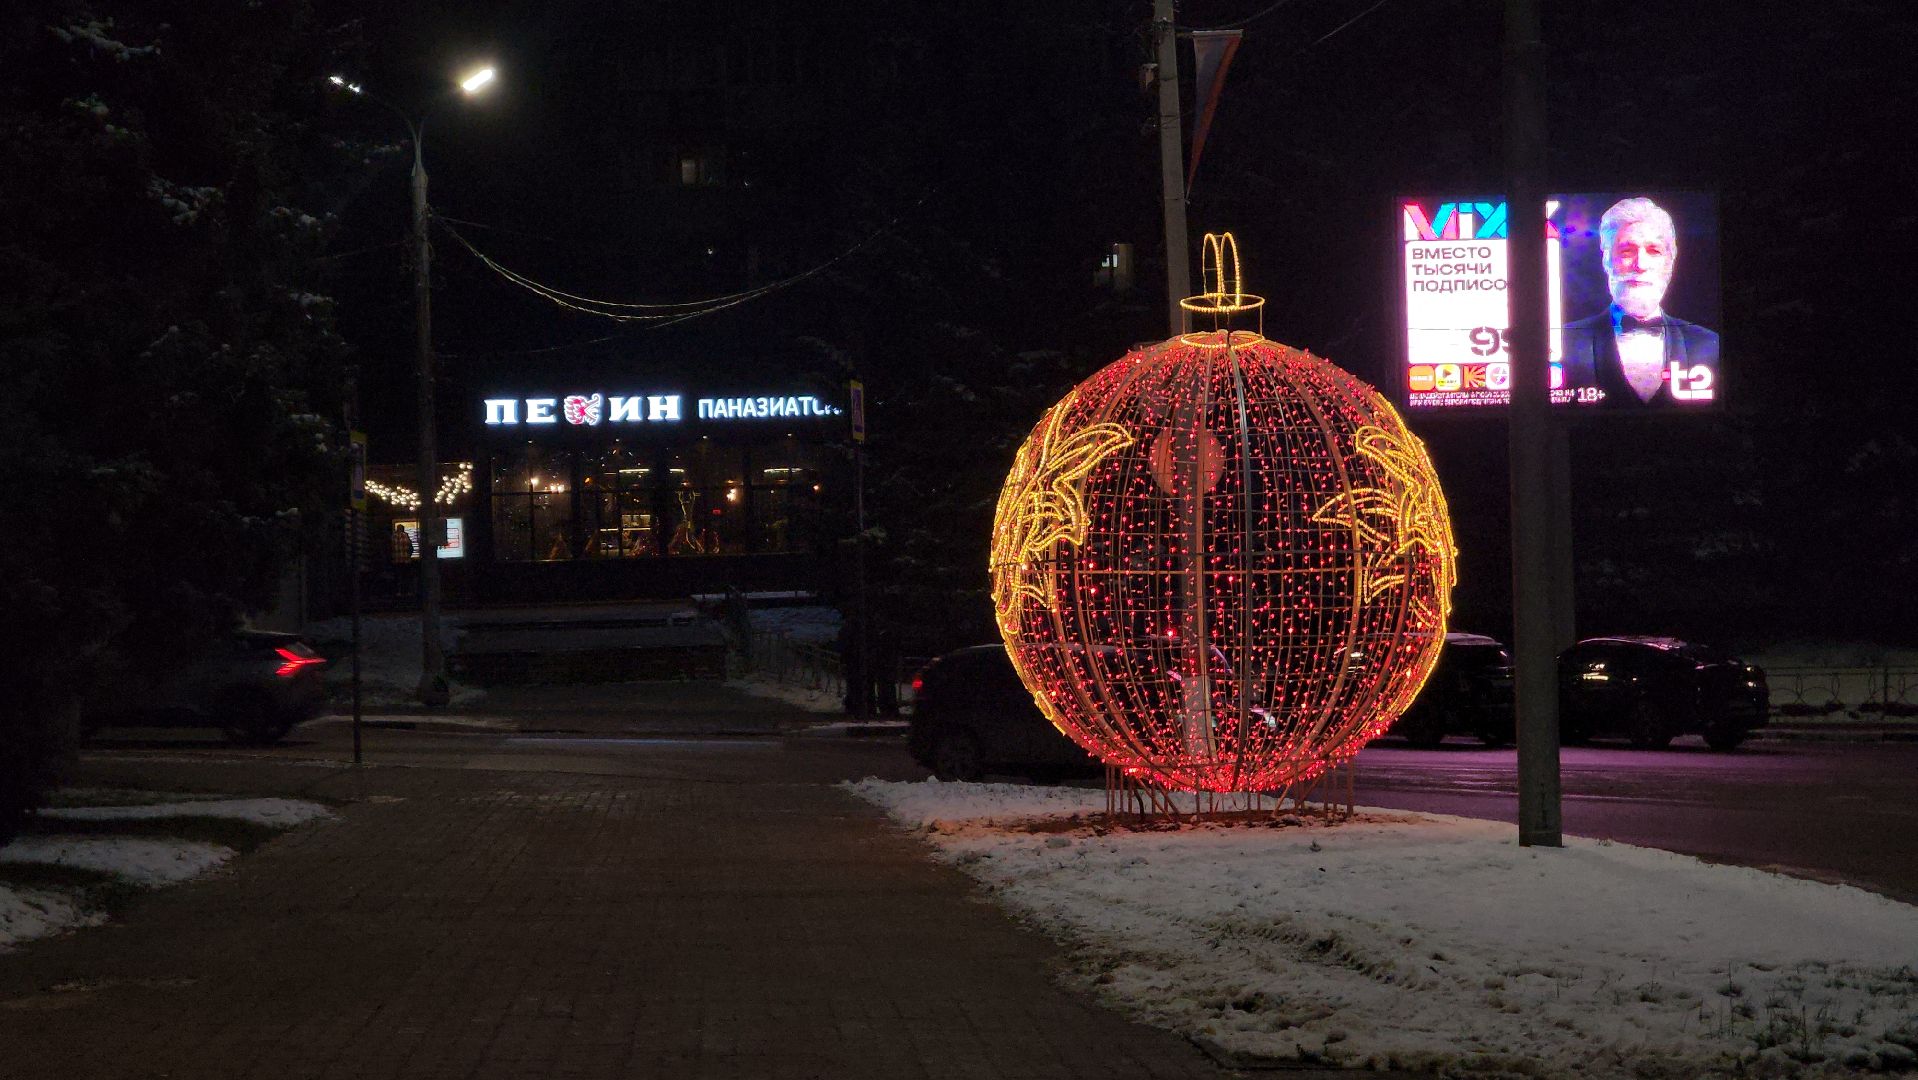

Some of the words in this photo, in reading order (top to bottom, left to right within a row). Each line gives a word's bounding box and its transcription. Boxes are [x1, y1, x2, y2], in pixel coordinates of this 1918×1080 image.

[1412, 246, 1492, 260] ВМЕСТО
[1411, 262, 1492, 276] ТЫСЯЧИ
[1412, 278, 1508, 294] ПОДПИСО
[1663, 360, 1713, 399] t2
[1577, 386, 1606, 402] 18+
